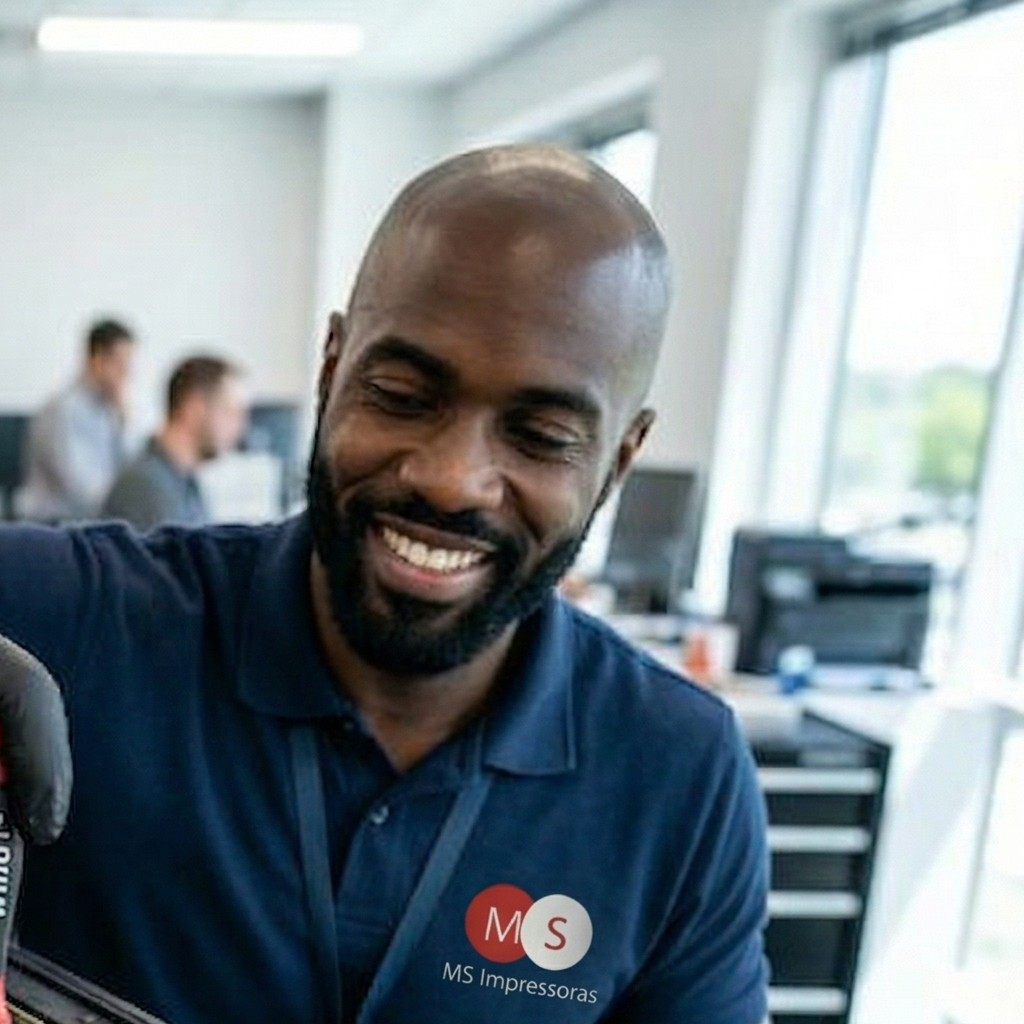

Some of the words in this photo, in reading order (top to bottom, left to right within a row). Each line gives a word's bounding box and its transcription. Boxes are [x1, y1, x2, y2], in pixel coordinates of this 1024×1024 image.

[544, 917, 568, 951] S
[442, 961, 474, 984] MS
[480, 968, 598, 1004] Impressoras
